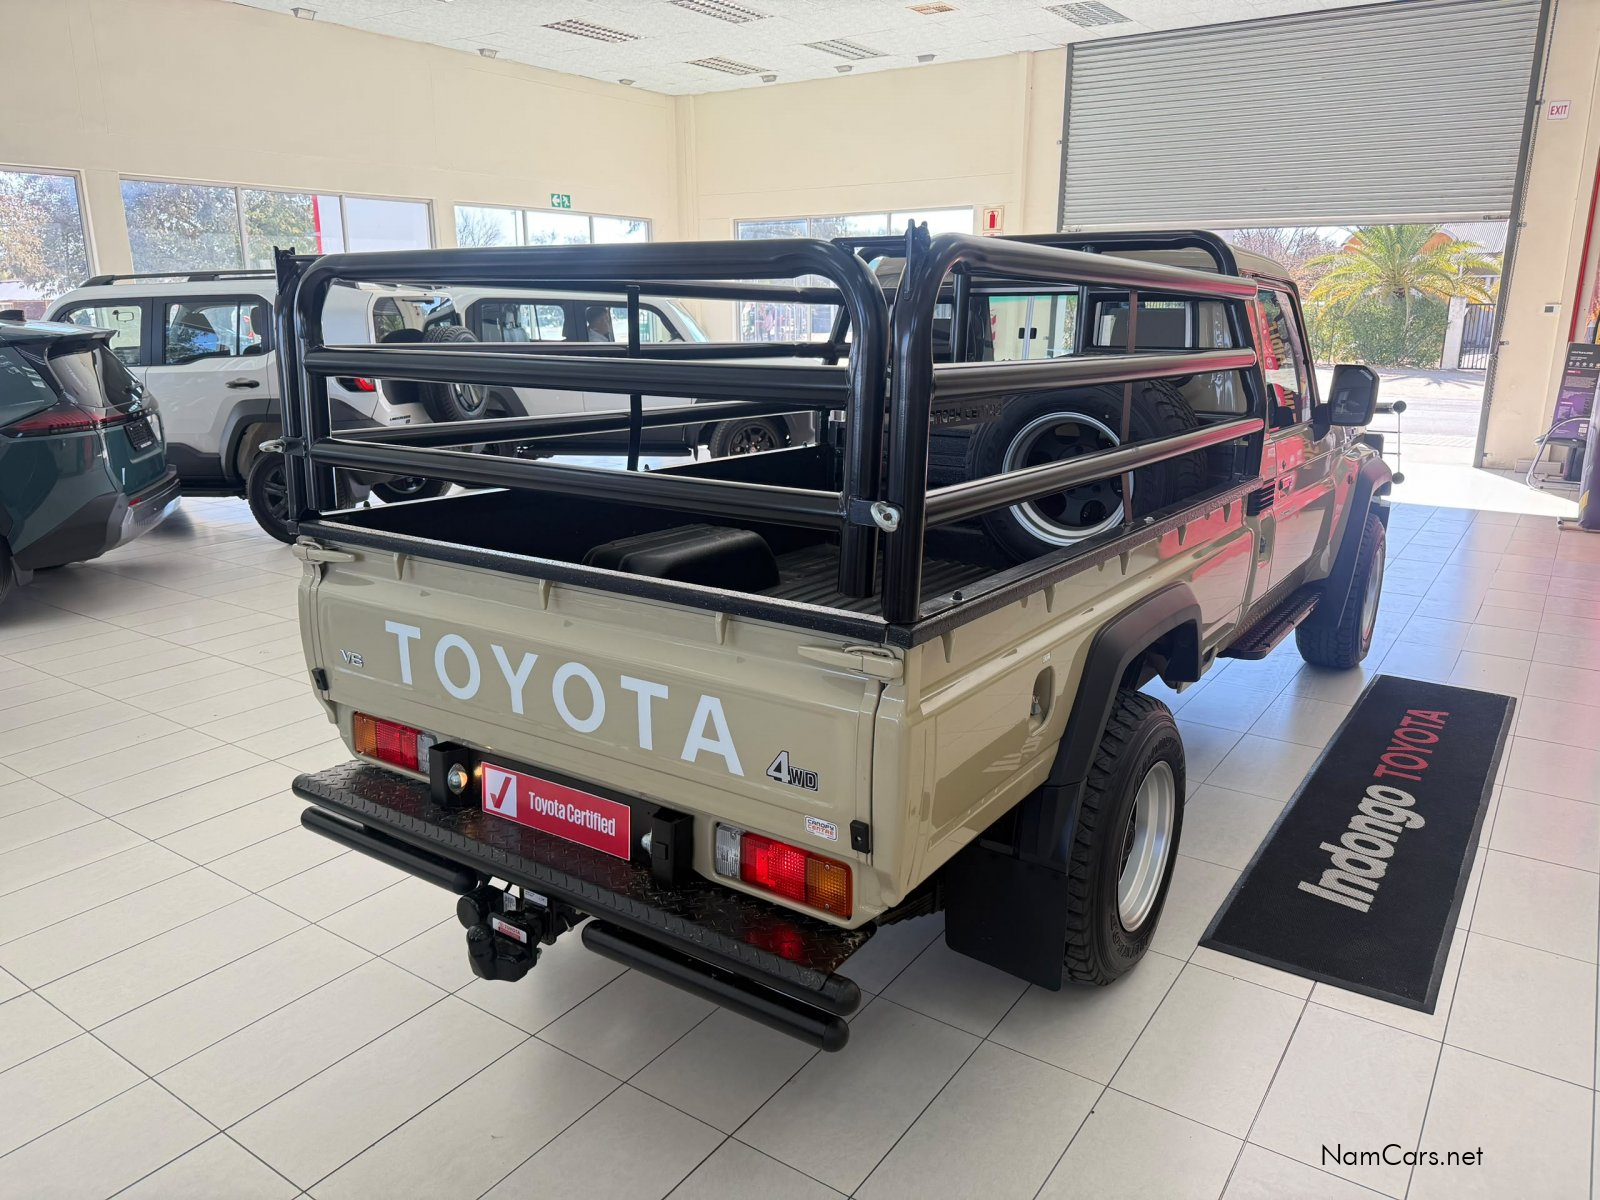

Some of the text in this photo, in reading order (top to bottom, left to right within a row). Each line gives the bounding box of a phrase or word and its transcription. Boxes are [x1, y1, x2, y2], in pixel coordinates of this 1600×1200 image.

[1550, 105, 1568, 115] EXIT
[385, 619, 745, 777] TOYOTA
[766, 749, 819, 792] 4WD
[528, 791, 616, 837] Toyota Certified
[1297, 708, 1450, 913] Indongo TOYOTA
